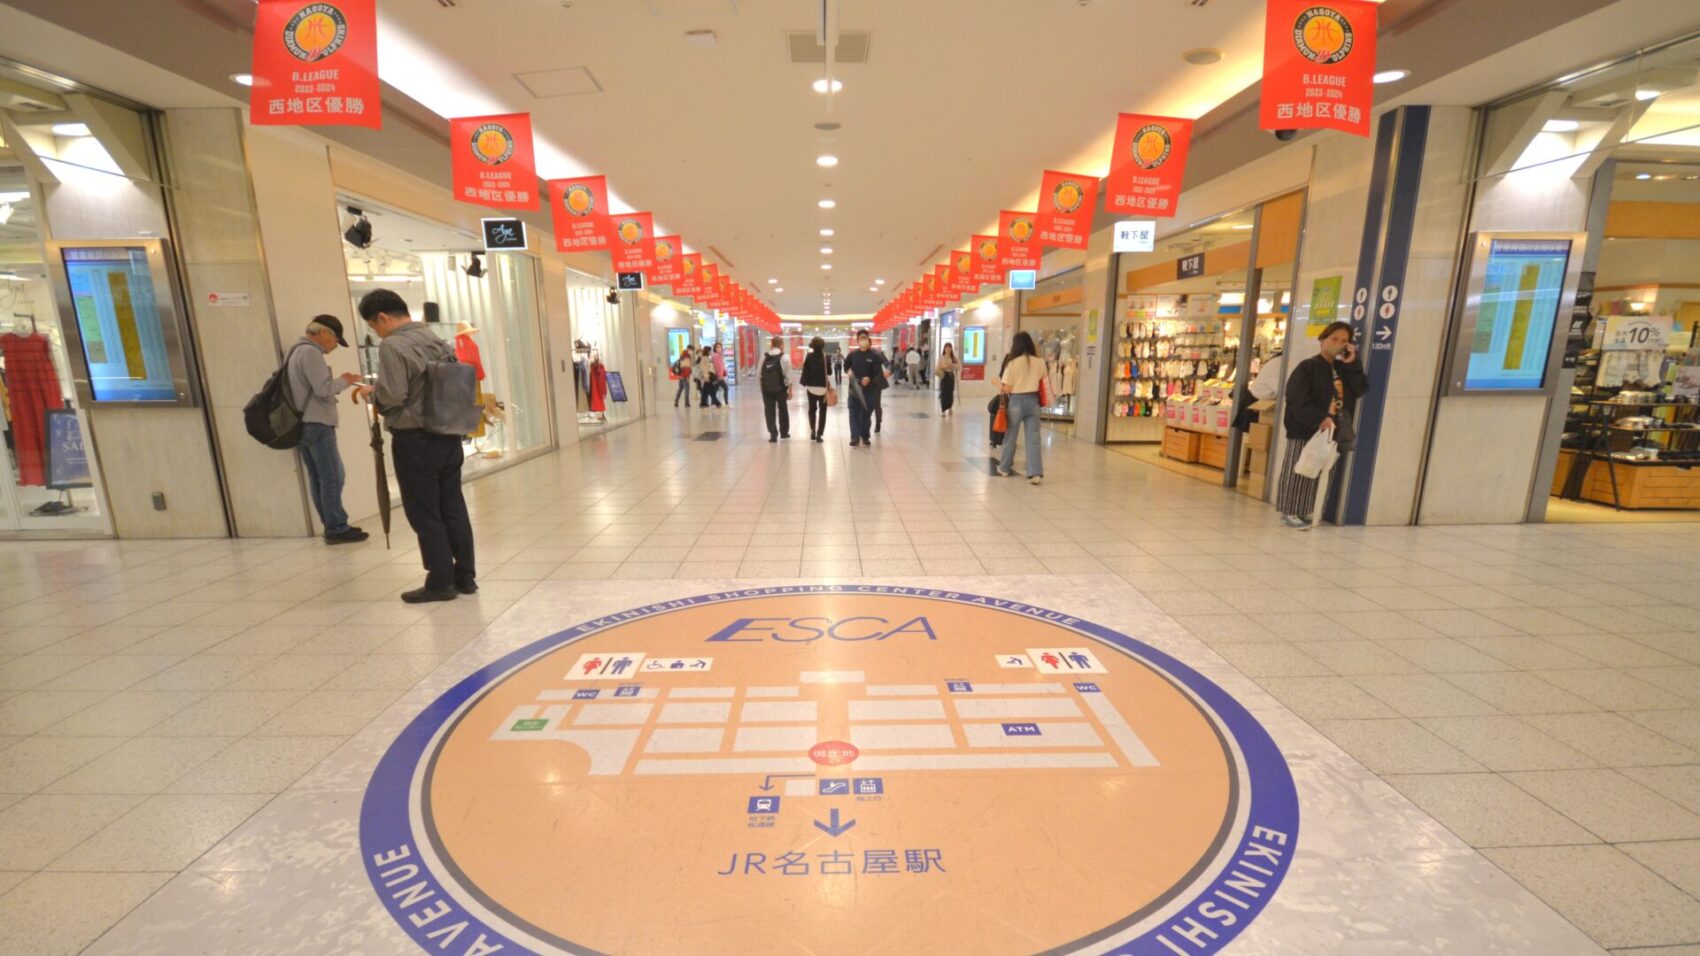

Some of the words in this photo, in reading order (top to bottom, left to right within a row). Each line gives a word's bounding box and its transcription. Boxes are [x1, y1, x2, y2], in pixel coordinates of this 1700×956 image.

[299, 4, 334, 18] NAGOYA
[1306, 8, 1341, 22] NAGOYA
[292, 68, 340, 82] B.LEAGUE
[1303, 74, 1346, 88] B.LEAGUE
[268, 97, 364, 115] 西地区優勝
[1277, 102, 1361, 124] 西地区優勝
[1114, 194, 1168, 210] 西地区優勝
[1120, 230, 1149, 240] 靴下屋
[576, 598, 694, 633] EKINISHI
[708, 585, 842, 600] SHOPPING
[858, 586, 960, 599] CENTER
[973, 596, 1081, 625] AVENUE
[704, 616, 937, 642] ESCA
[576, 691, 598, 699] WC
[1077, 684, 1097, 692] WC
[1007, 725, 1036, 733] ATM
[718, 848, 946, 876] JR名古屋駅
[1156, 825, 1288, 956] EKINISHI
[373, 844, 504, 956] AVENUE
